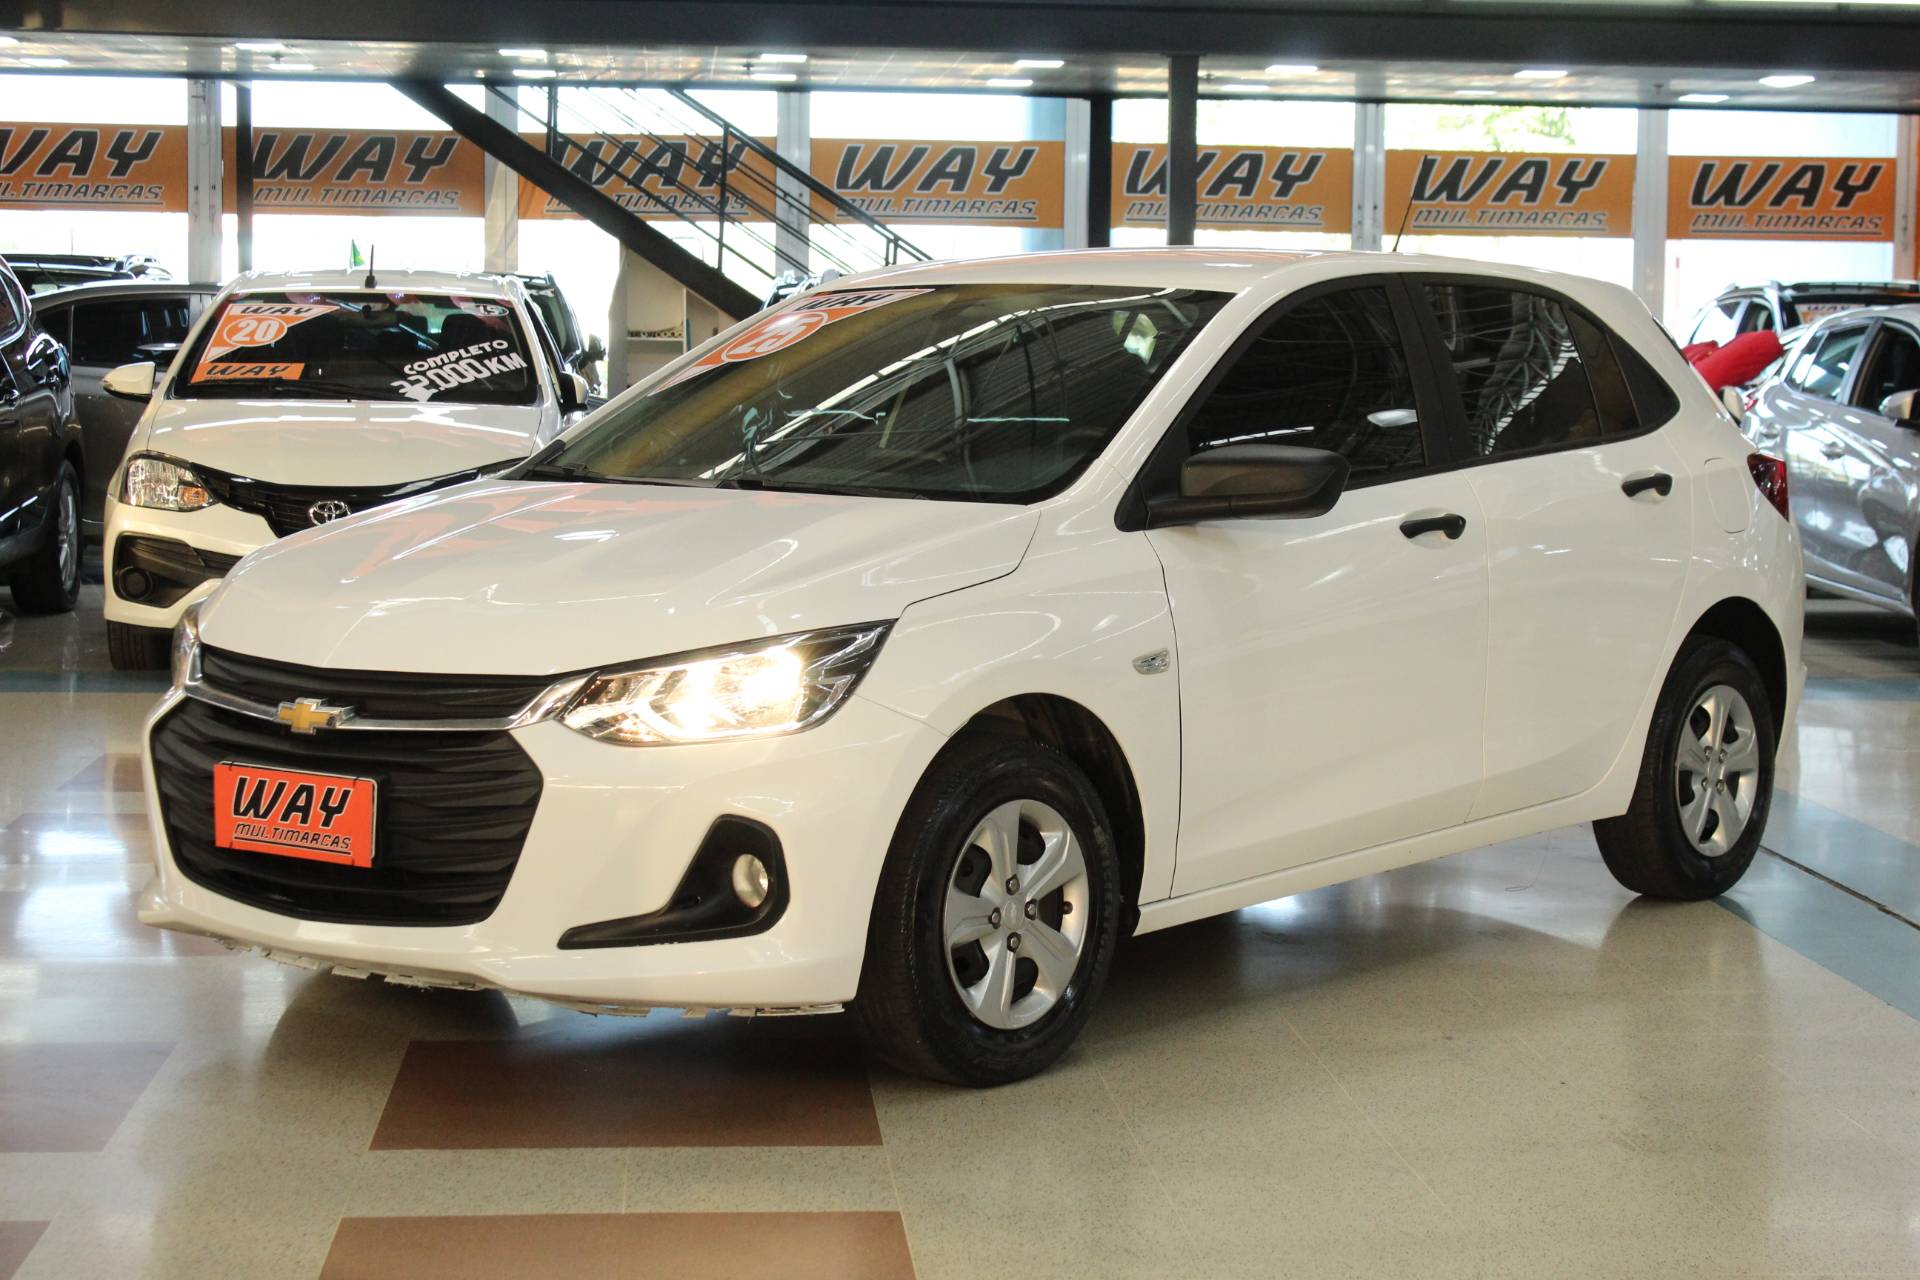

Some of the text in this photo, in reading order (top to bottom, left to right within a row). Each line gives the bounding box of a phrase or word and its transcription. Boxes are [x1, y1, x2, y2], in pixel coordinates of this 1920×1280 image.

[253, 133, 461, 183] WAY
[835, 144, 1039, 194] WAY
[1124, 149, 1326, 199] WAY
[1411, 156, 1610, 206] WAY
[1690, 162, 1886, 210] WAY
[0, 182, 163, 199] LTIMARCAS
[1414, 209, 1607, 225] MULTIMARCAS
[1692, 214, 1883, 230] MULTIMARCAS
[240, 306, 313, 315] WAY
[232, 319, 280, 342] 20
[206, 365, 293, 376] WAY
[403, 340, 508, 375] COMPLETO
[232, 776, 353, 829] WAY
[234, 822, 352, 850] MULTIMARCAS
